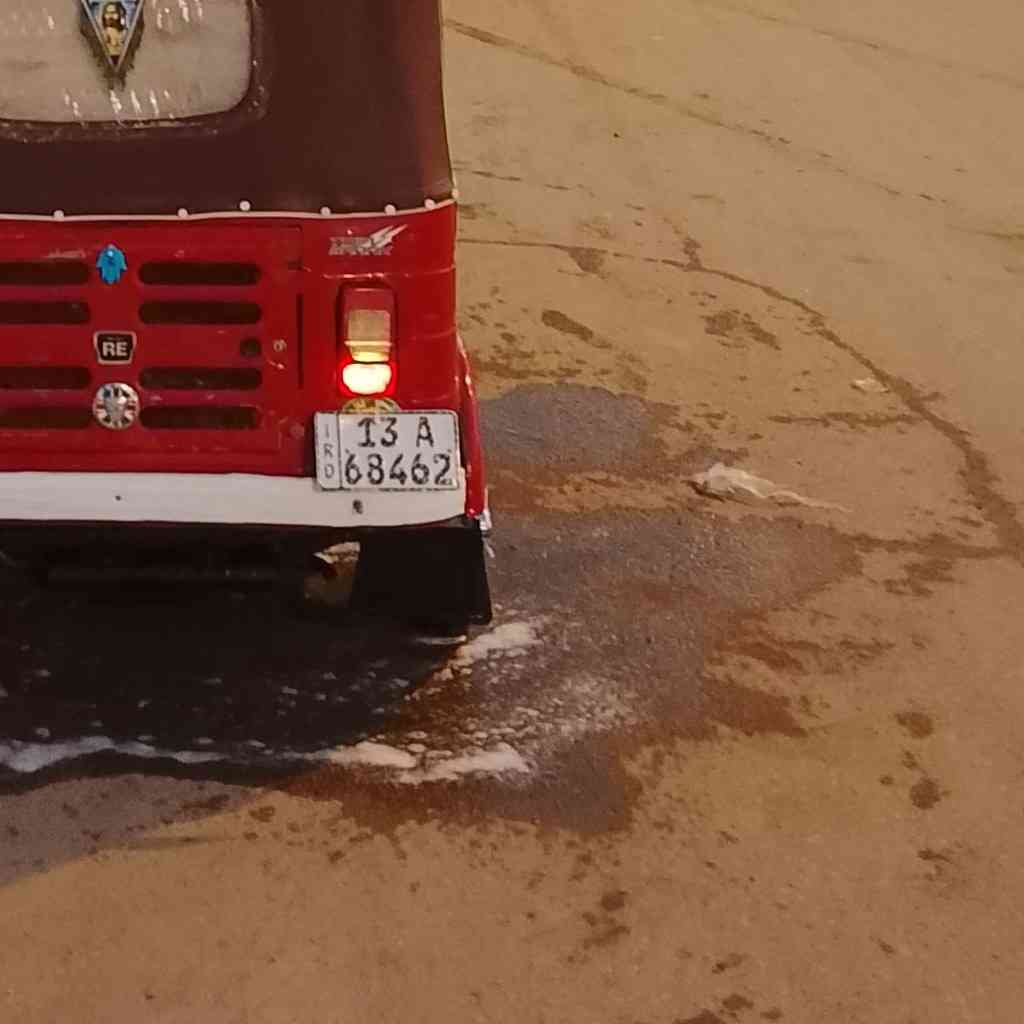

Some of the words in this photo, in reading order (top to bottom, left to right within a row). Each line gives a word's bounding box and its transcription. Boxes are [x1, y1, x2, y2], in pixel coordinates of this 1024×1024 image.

[102, 341, 128, 357] RE
[358, 417, 398, 447] 13
[416, 416, 434, 448] A
[345, 453, 452, 485] 68462
